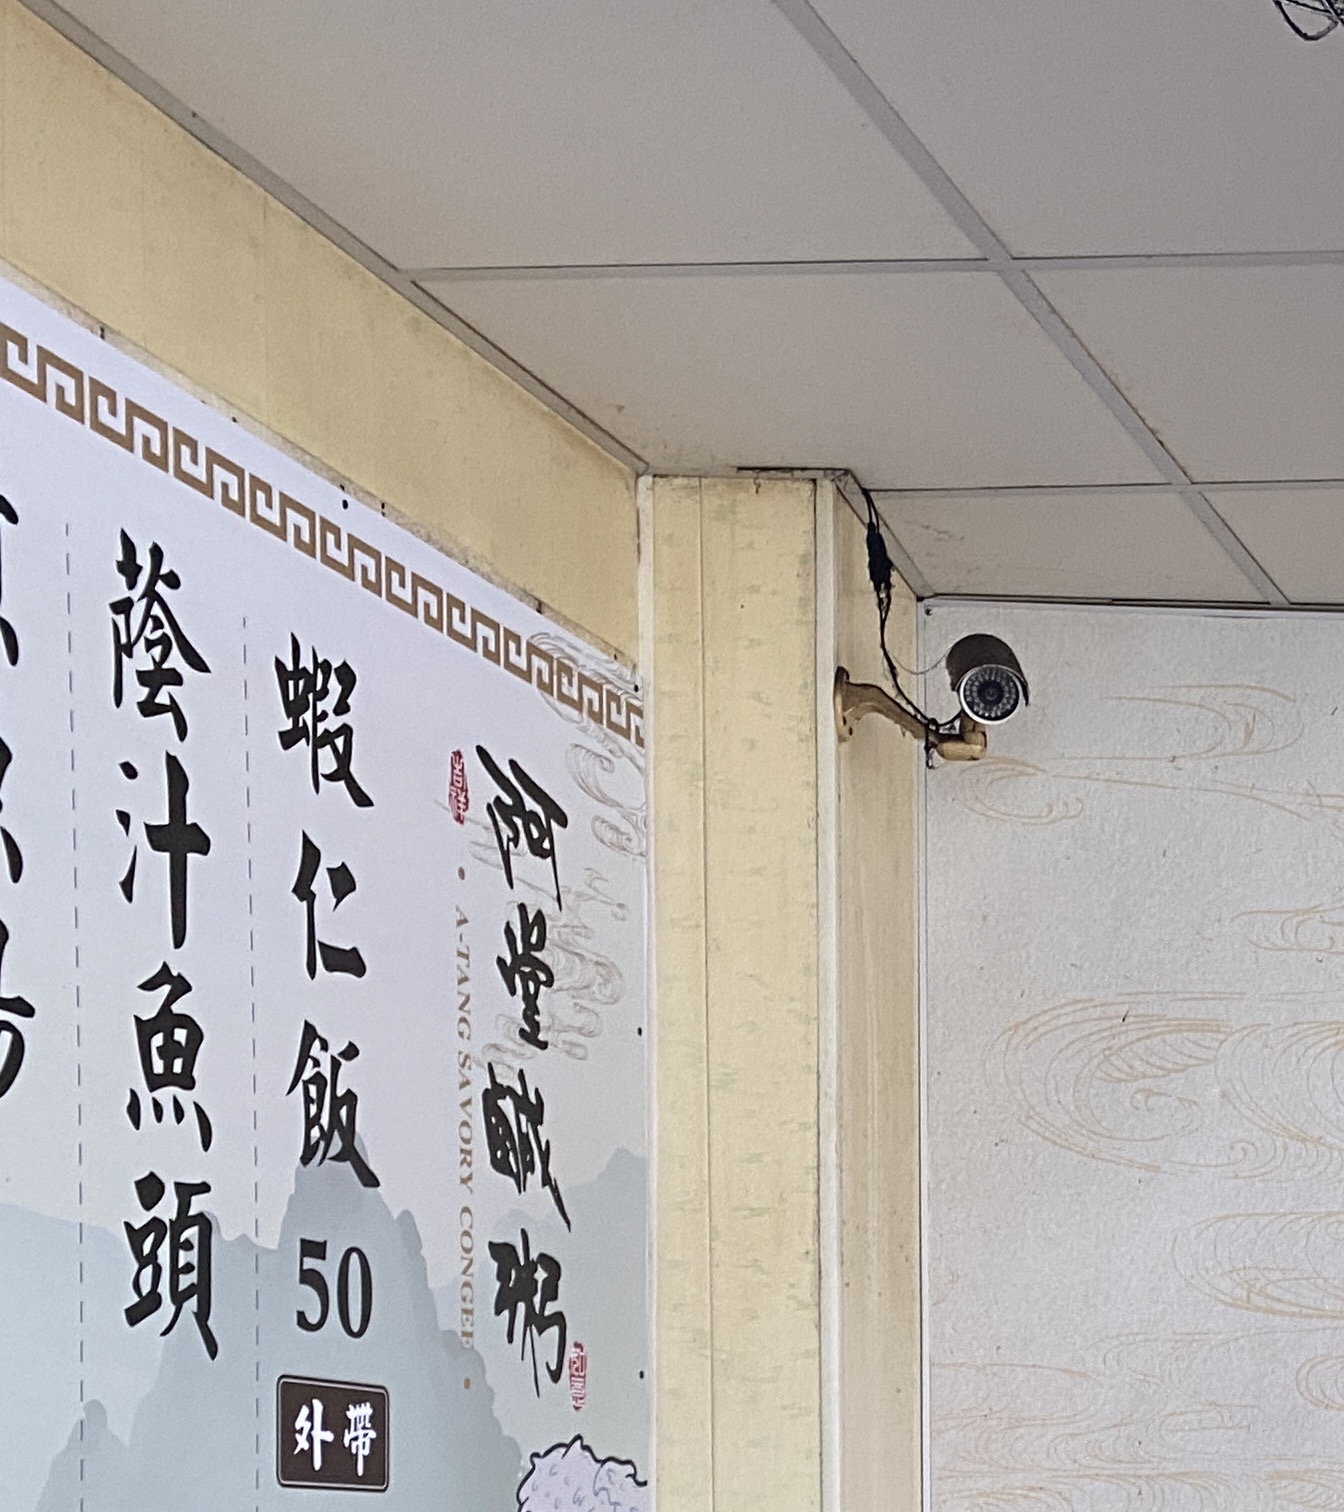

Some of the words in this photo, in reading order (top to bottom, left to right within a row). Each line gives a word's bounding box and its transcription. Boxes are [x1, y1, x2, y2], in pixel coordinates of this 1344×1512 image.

[110, 528, 219, 1361] 蔭汁魚頭
[274, 632, 381, 1188] 蝦仁飯
[455, 904, 471, 1041] A-TANG
[457, 1050, 474, 1194] SAVORY
[475, 745, 570, 1397] 阿堂鹹粥
[296, 1237, 373, 1339] 50
[459, 1206, 474, 1350] CONGEE
[293, 1398, 377, 1477] 外帶
